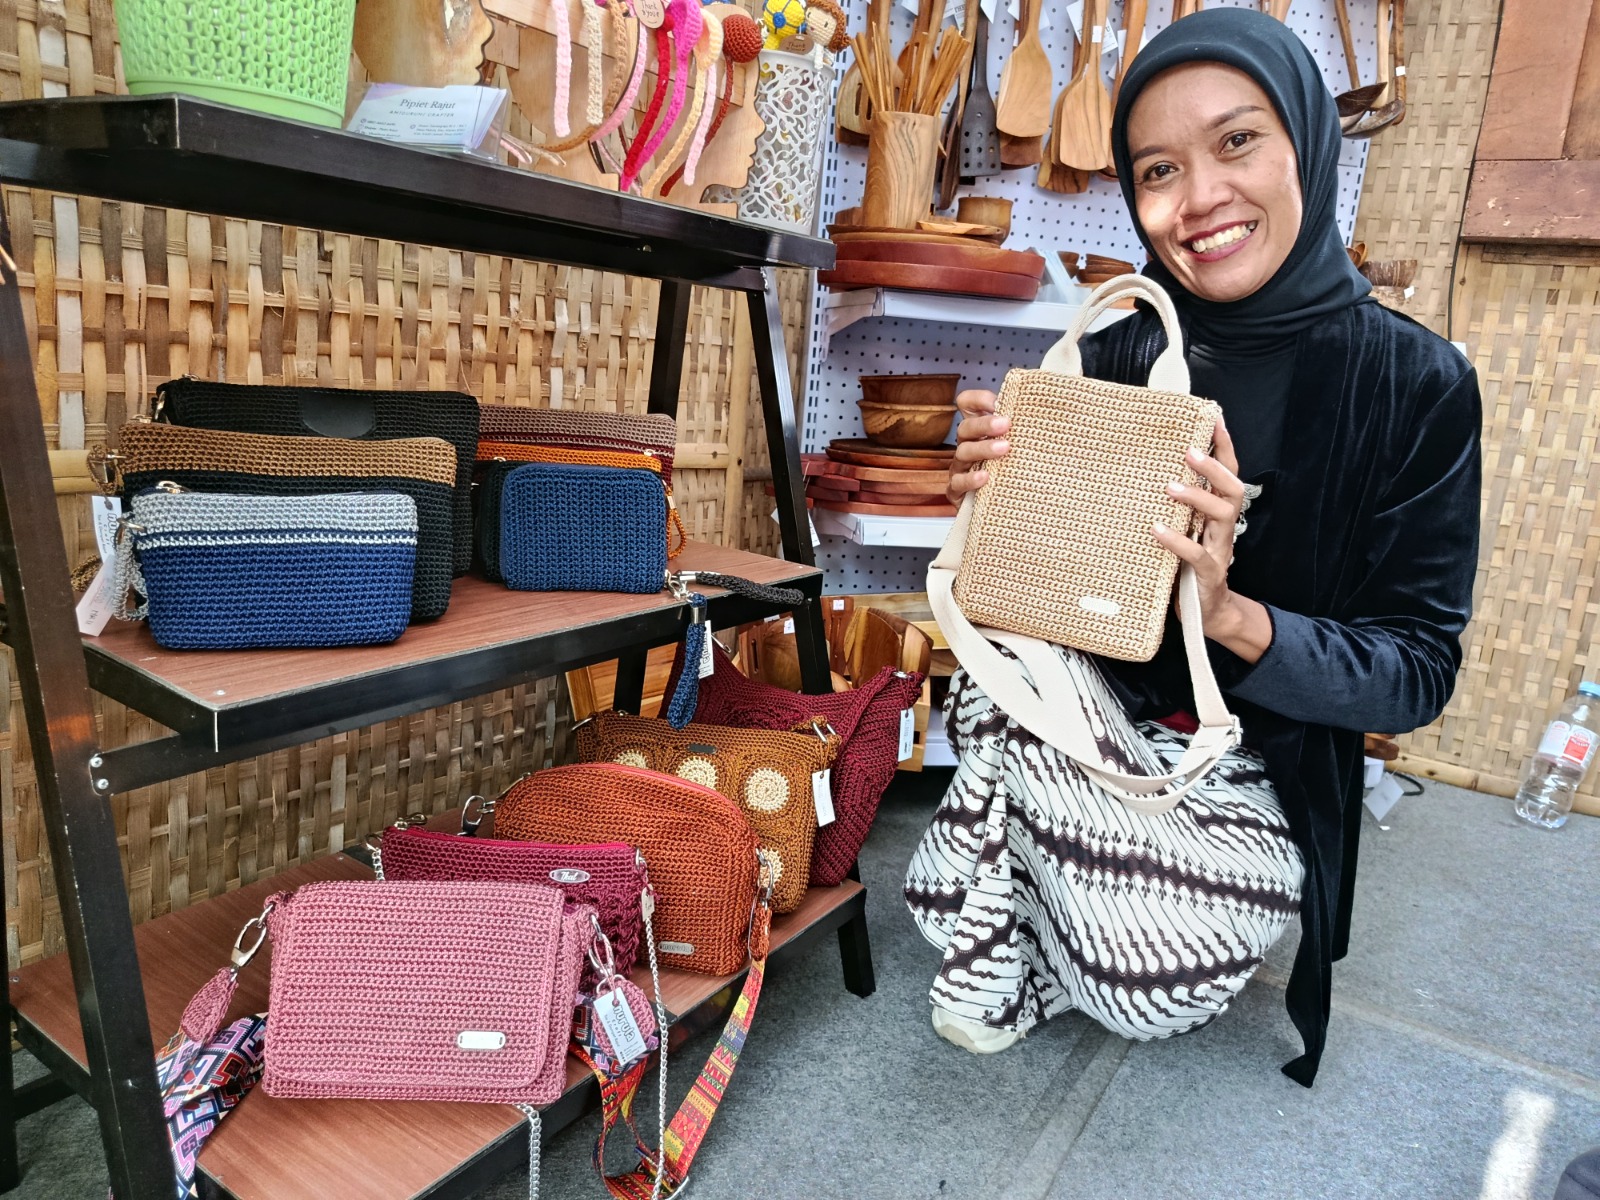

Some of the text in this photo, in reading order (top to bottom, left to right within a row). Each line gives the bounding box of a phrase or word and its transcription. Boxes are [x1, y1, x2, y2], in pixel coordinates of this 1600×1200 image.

[400, 98, 456, 111] Pipiet Rajut
[613, 1004, 636, 1042] nurula
